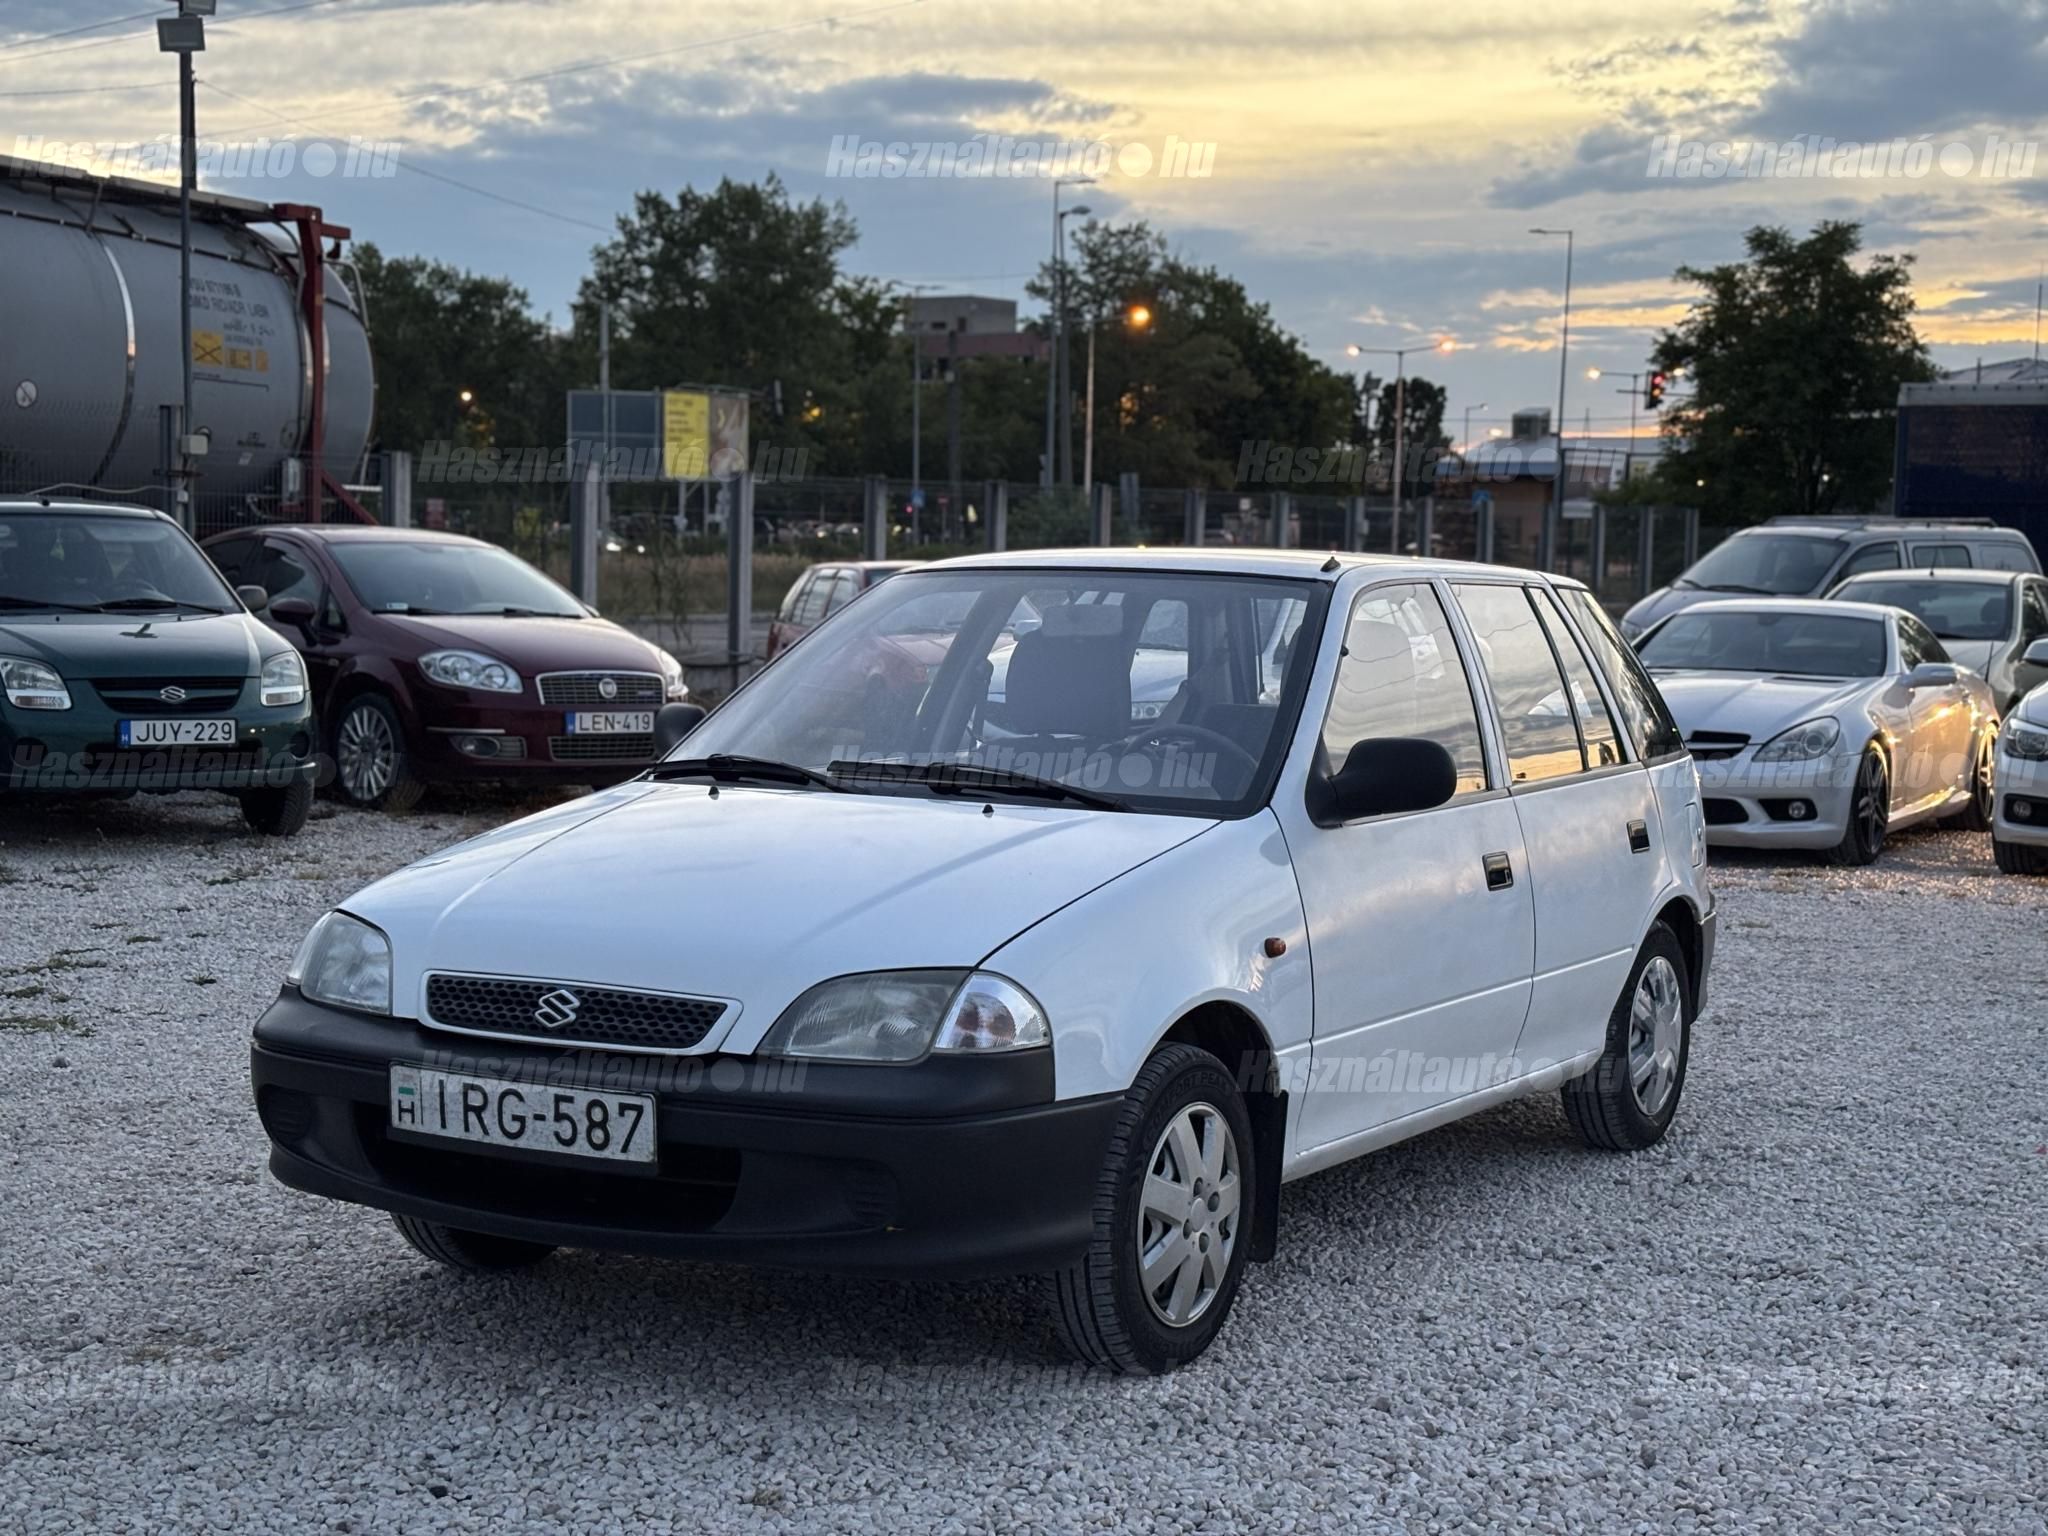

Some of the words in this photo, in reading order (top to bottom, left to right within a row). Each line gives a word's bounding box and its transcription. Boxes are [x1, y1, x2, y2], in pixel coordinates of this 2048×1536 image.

[136, 722, 232, 742] JUY-229
[579, 713, 651, 731] LEN-419
[398, 1098, 416, 1125] H
[438, 1079, 645, 1154] IRG-587
